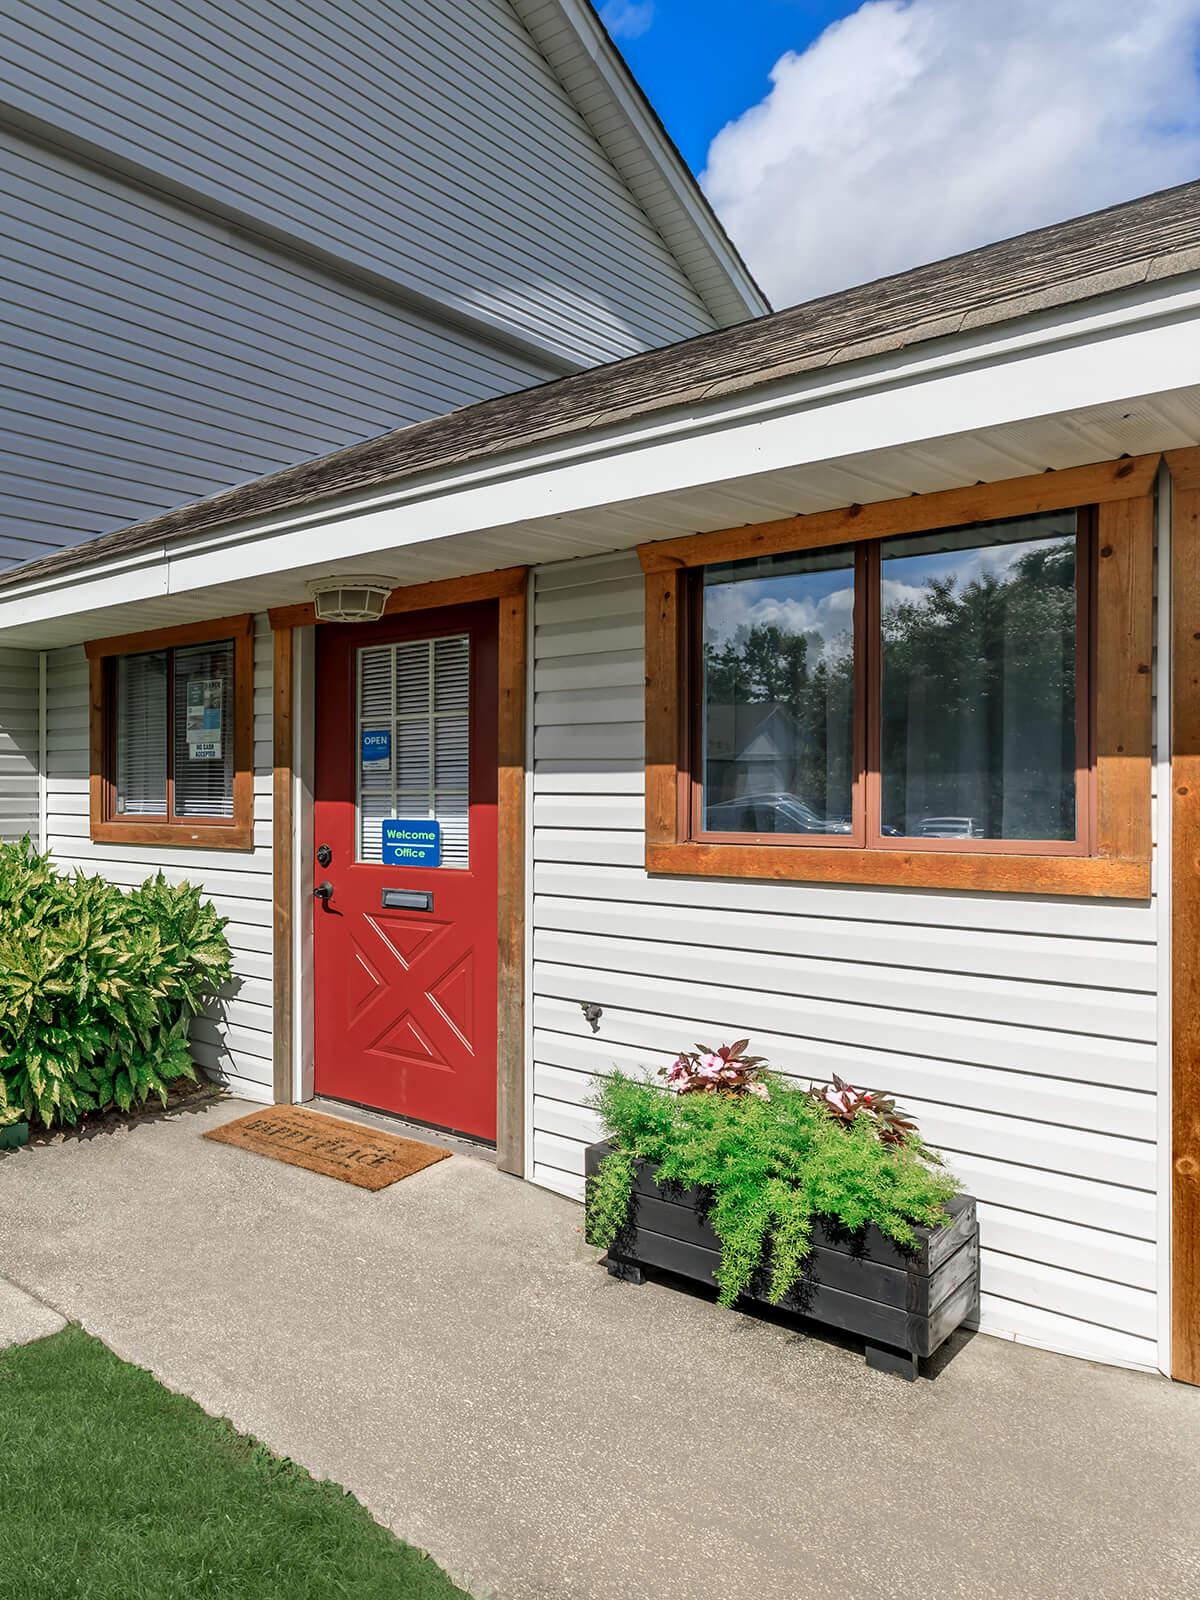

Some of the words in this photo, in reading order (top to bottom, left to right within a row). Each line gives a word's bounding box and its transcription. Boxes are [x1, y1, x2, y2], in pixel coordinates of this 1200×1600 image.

[364, 736, 388, 745] OPEN
[386, 829, 436, 840] Welcome
[394, 847, 426, 858] Office
